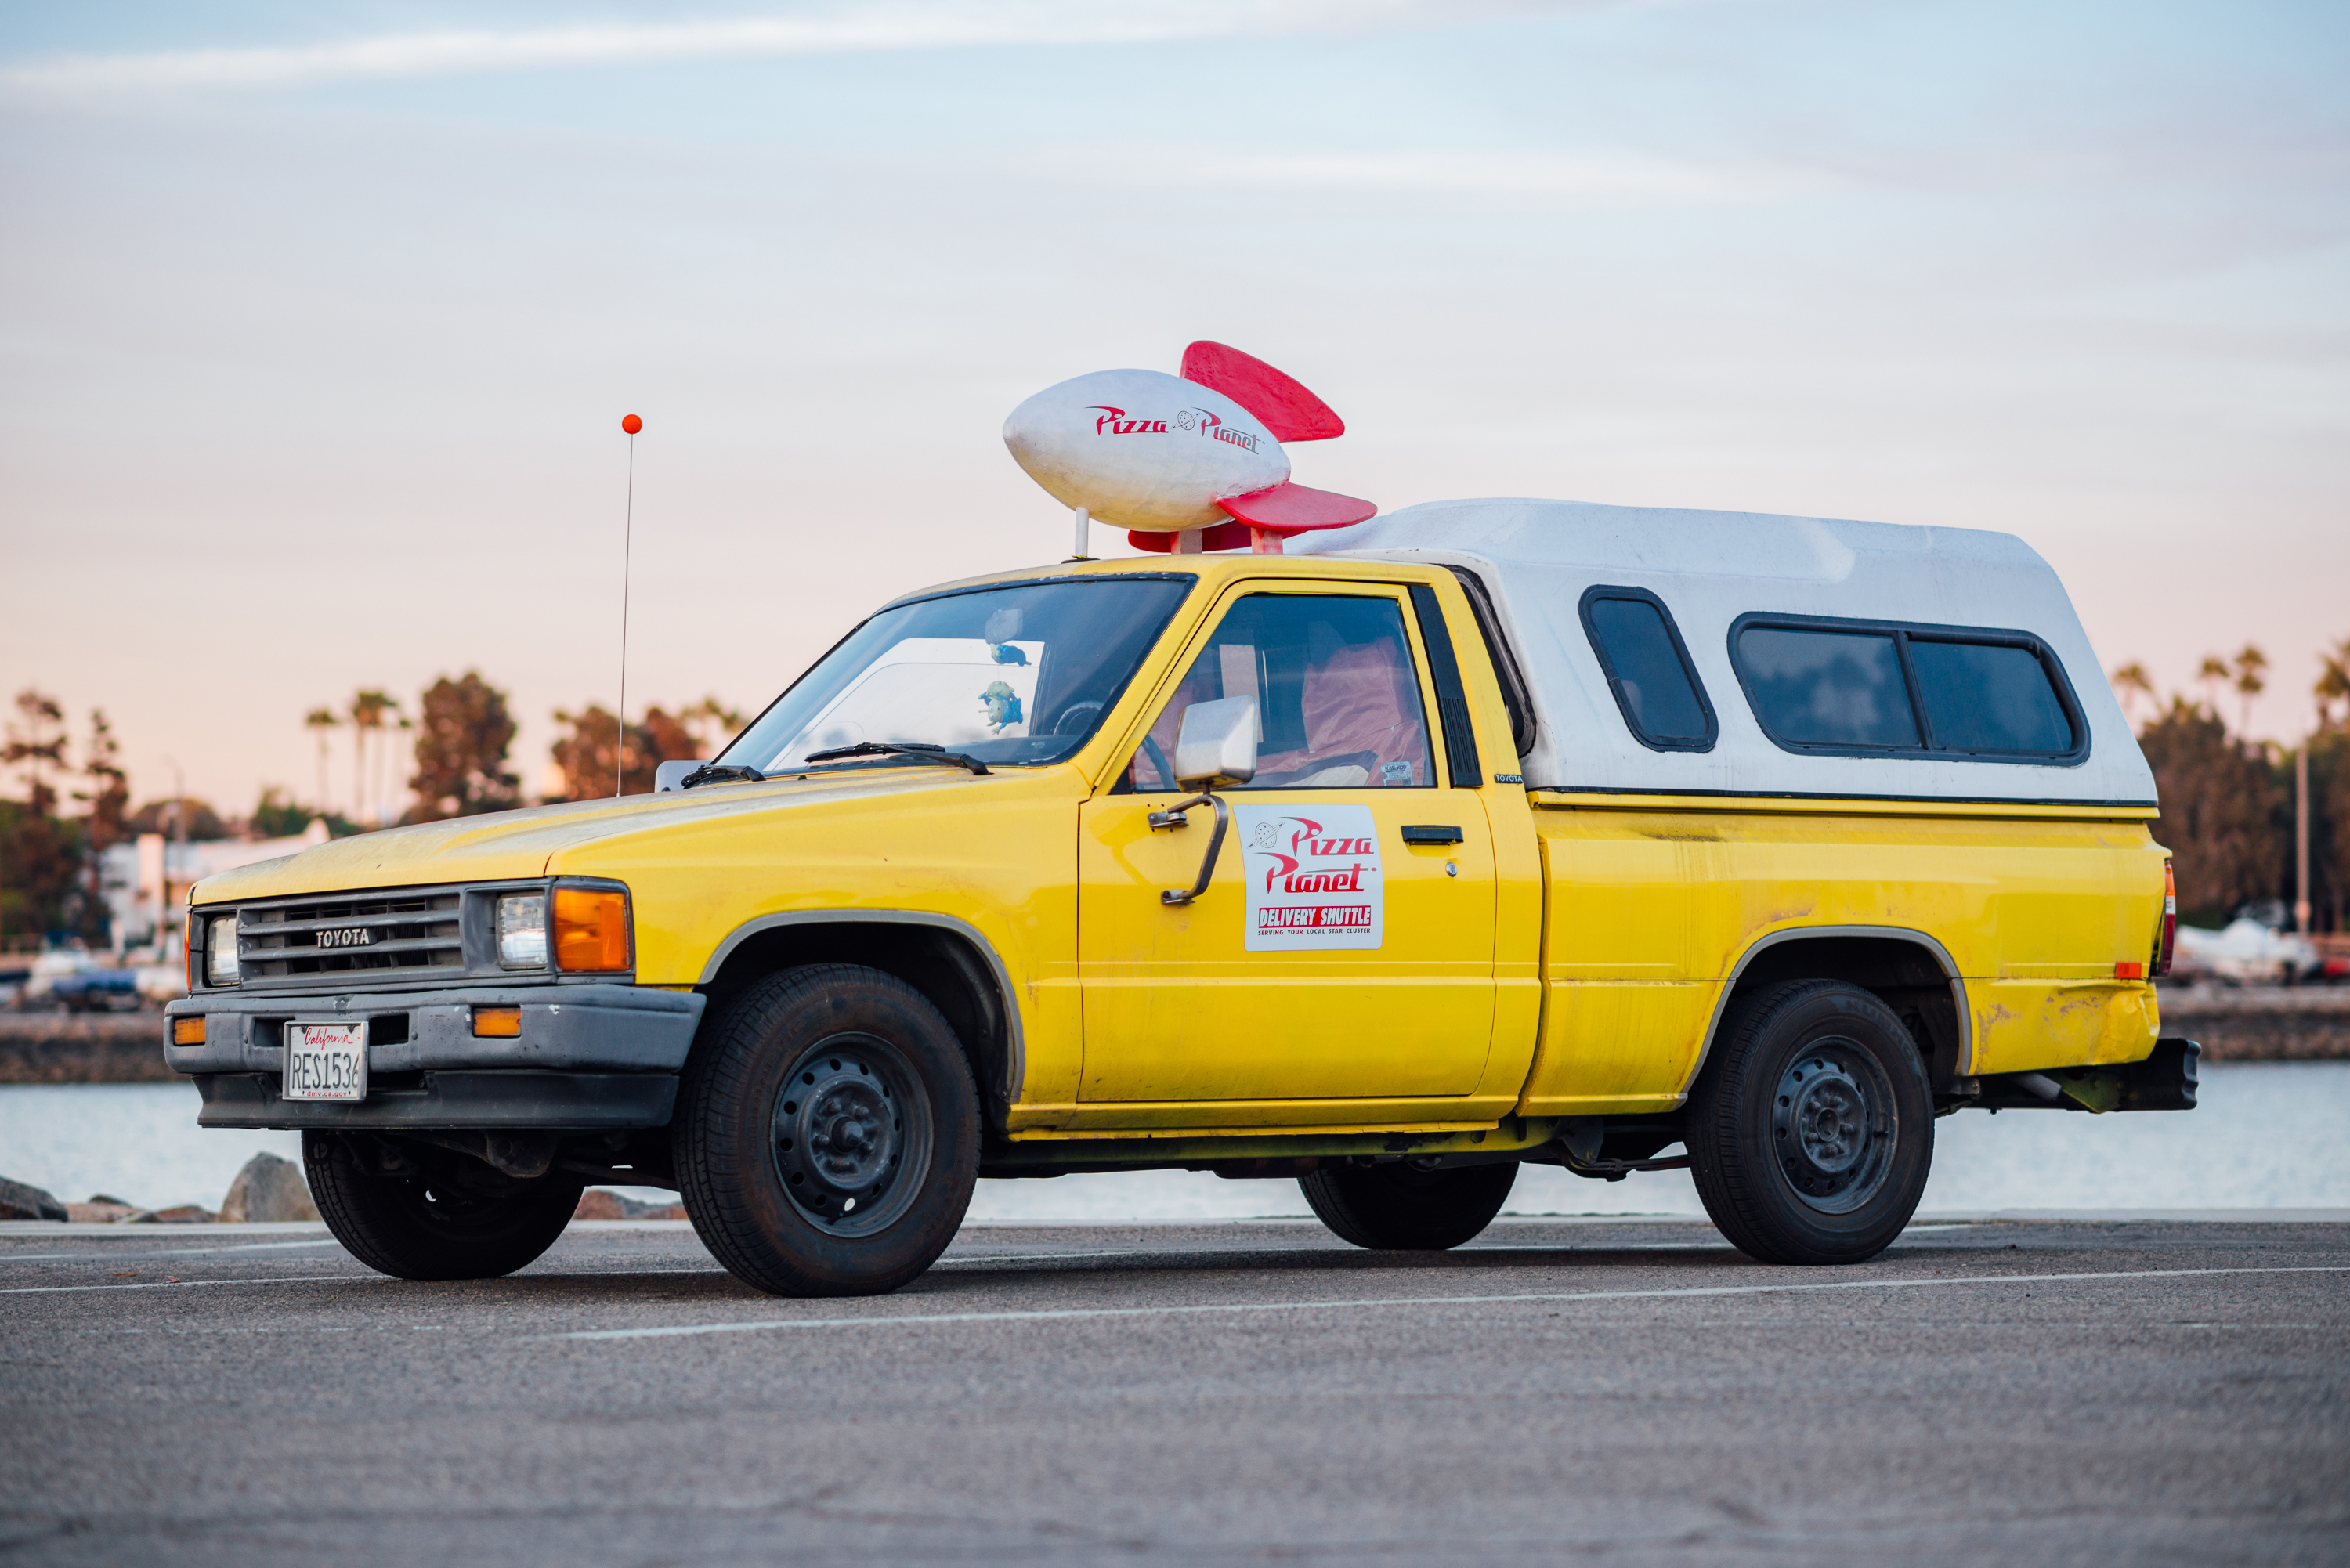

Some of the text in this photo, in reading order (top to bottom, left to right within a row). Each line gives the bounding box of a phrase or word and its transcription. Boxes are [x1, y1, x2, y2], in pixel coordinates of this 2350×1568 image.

[1084, 406, 1260, 455] Pizza Planet
[1277, 816, 1374, 857] Pizza
[1253, 851, 1371, 894] Planet
[1259, 906, 1371, 927] DELIVERY SHUTTLE
[316, 928, 369, 948] TOYOTA
[305, 1027, 353, 1050] California
